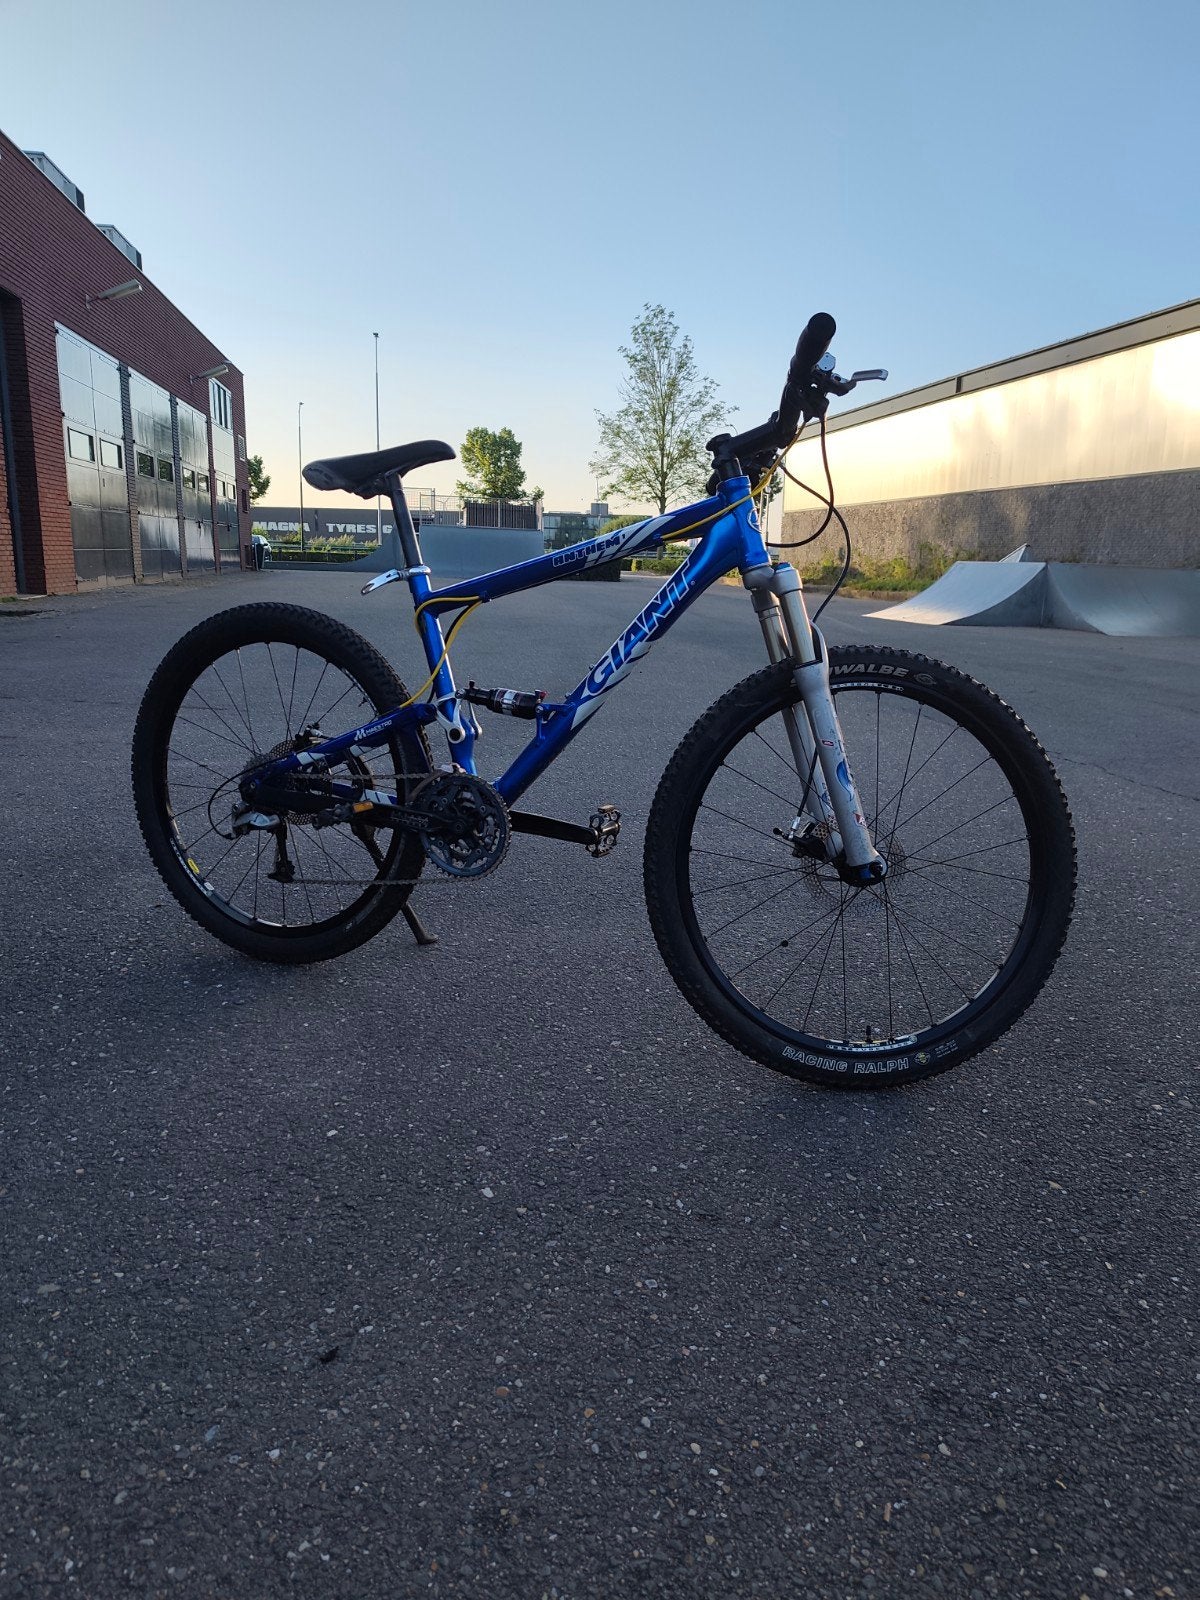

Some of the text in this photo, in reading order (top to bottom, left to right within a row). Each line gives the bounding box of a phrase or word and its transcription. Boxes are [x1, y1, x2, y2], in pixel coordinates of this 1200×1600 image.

[252, 521, 394, 534] MAGNA TYRES G
[553, 535, 620, 567] ANTHEM
[586, 558, 691, 696] GIANT
[782, 1046, 909, 1073] RACING RALPH
